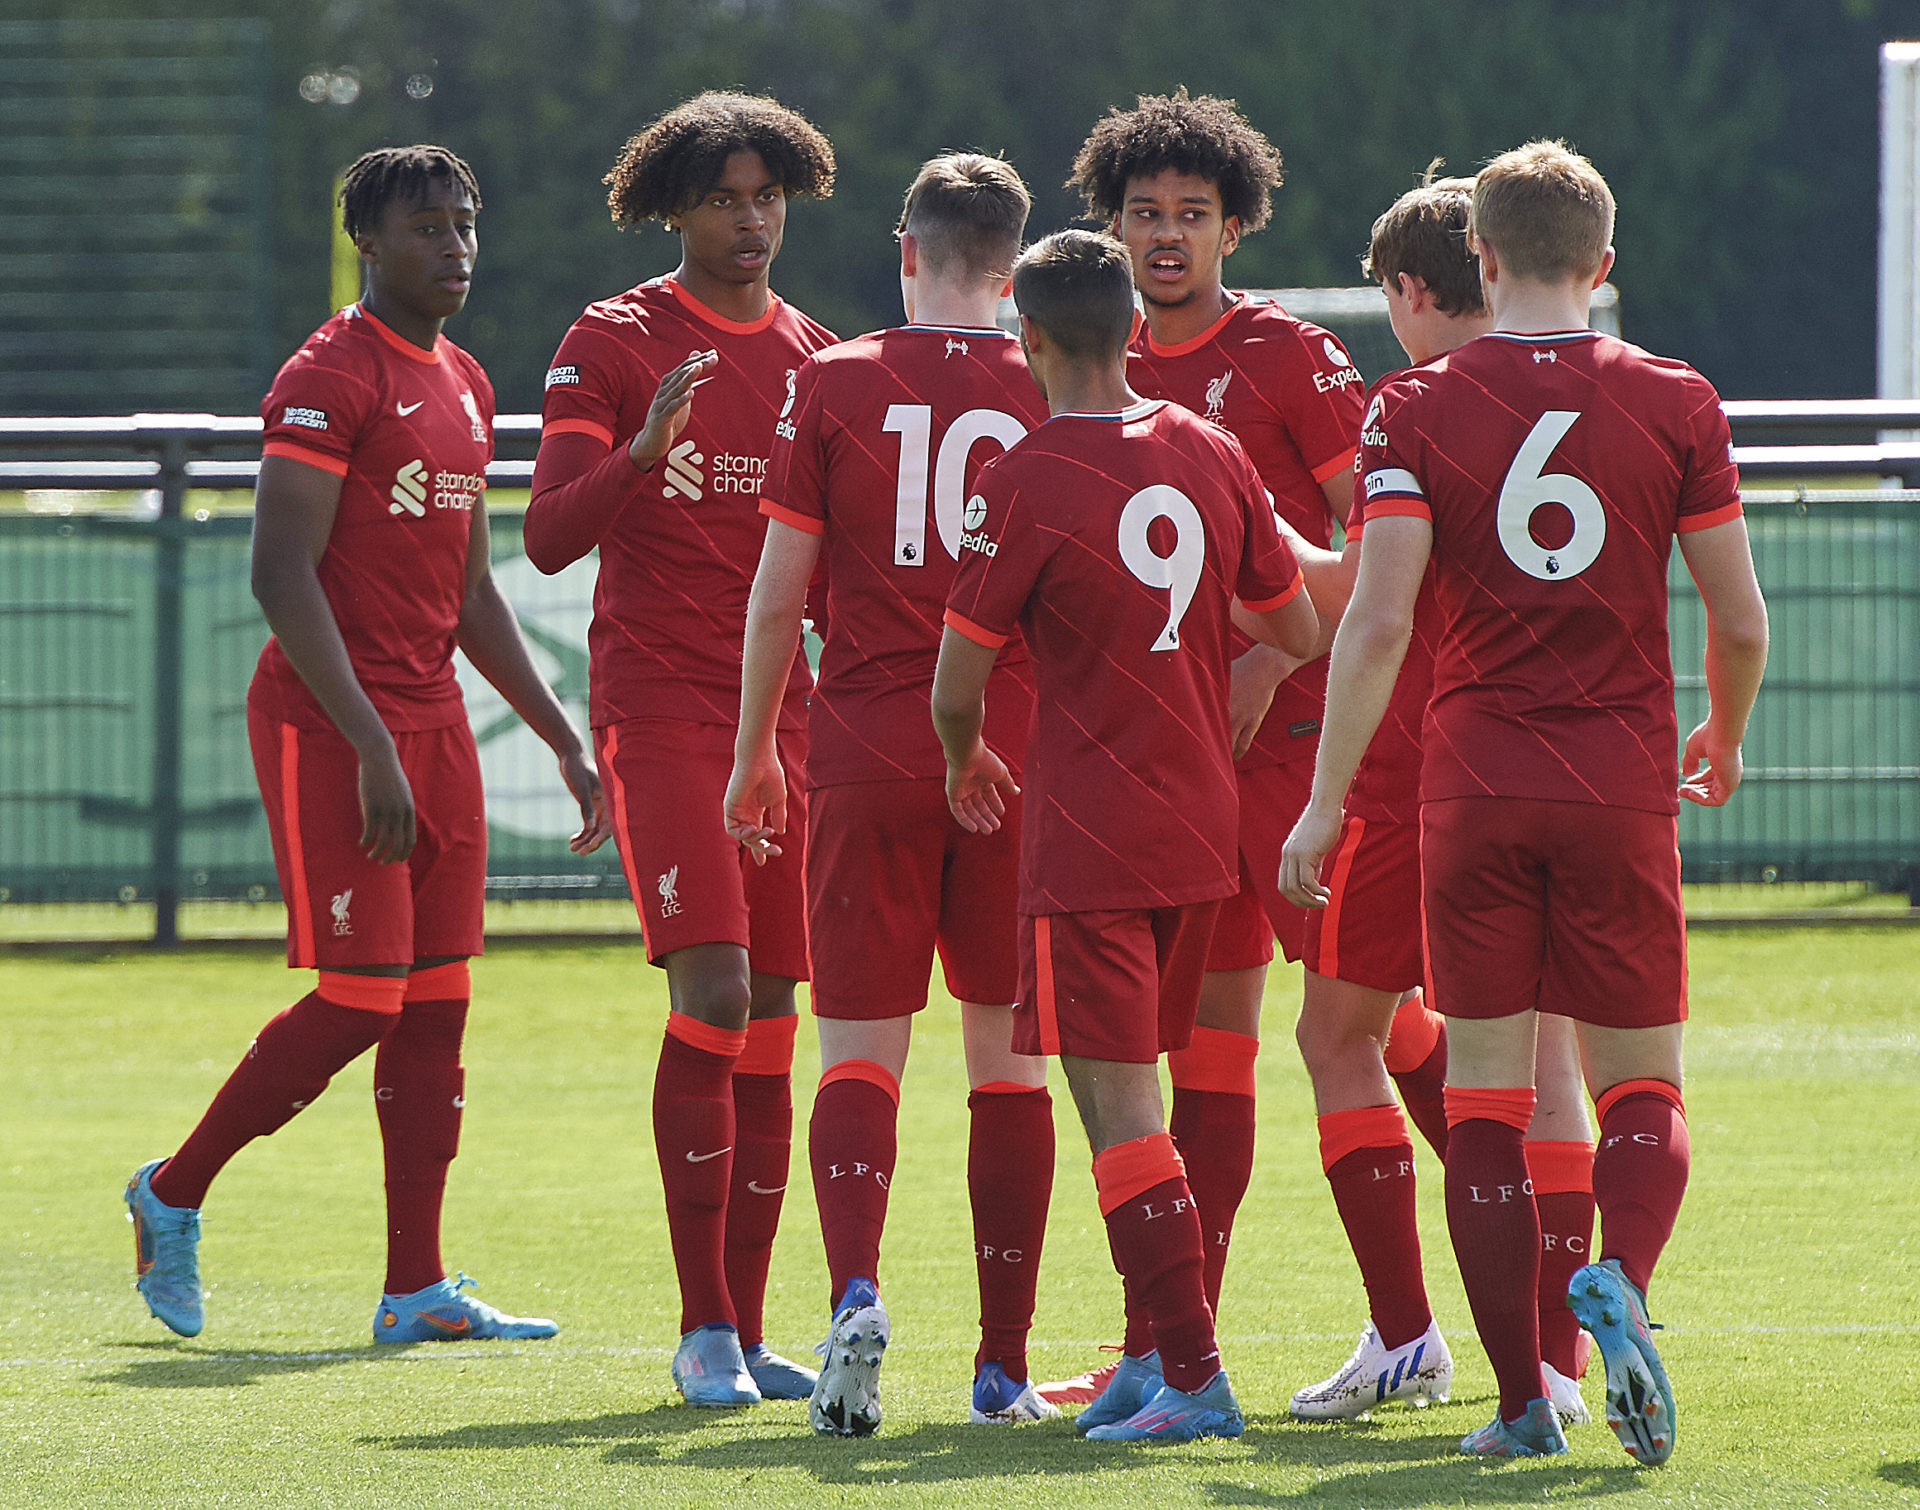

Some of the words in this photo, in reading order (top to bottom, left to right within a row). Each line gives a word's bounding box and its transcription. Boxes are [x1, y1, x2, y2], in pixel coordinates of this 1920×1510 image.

[882, 404, 1028, 567] 10
[1117, 484, 1205, 652] 9
[1496, 411, 1607, 580] 6
[661, 903, 684, 919] LFC
